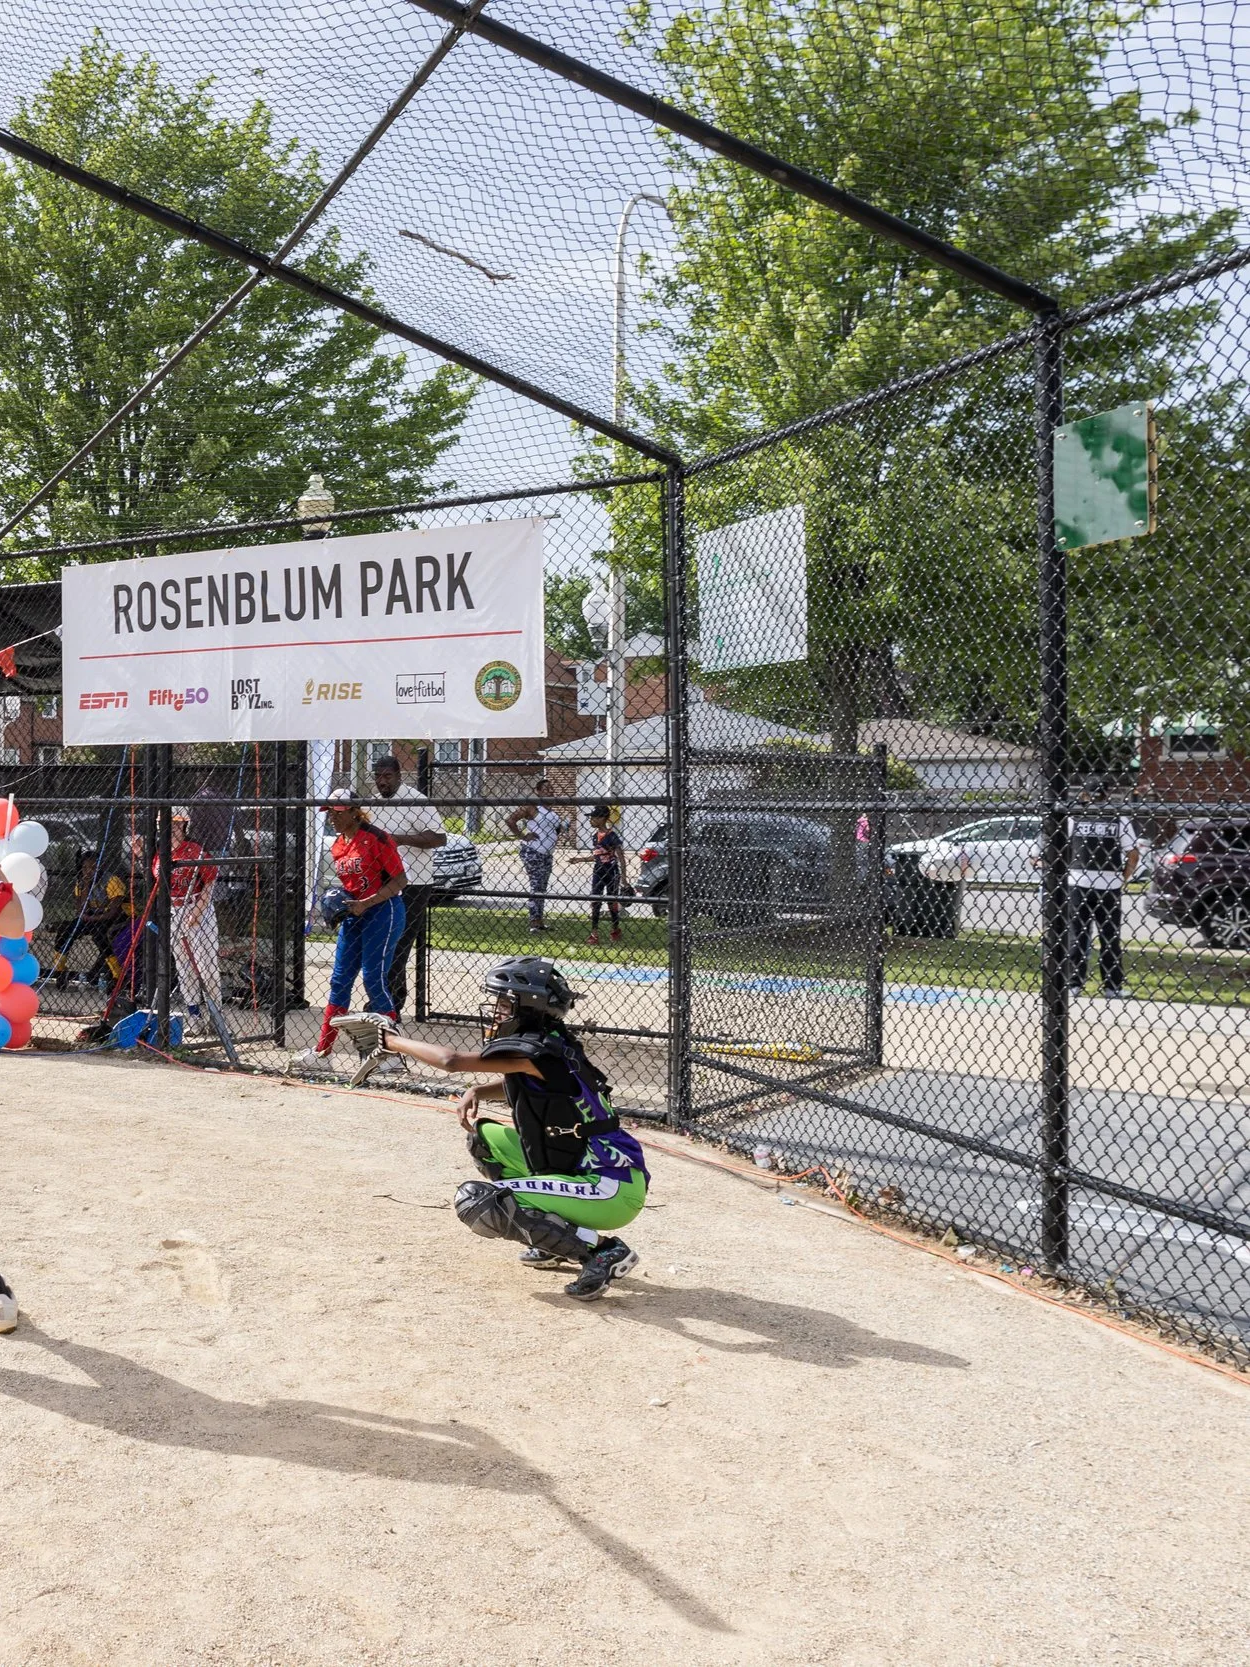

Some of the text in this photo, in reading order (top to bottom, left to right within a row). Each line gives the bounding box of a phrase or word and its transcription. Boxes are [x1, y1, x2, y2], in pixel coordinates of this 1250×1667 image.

[114, 551, 475, 635] ROSENBLUM PARK
[231, 678, 261, 695] LOST
[316, 682, 363, 701] RISE
[79, 691, 129, 710] ESPN
[498, 1181, 600, 1196] THUNDE
